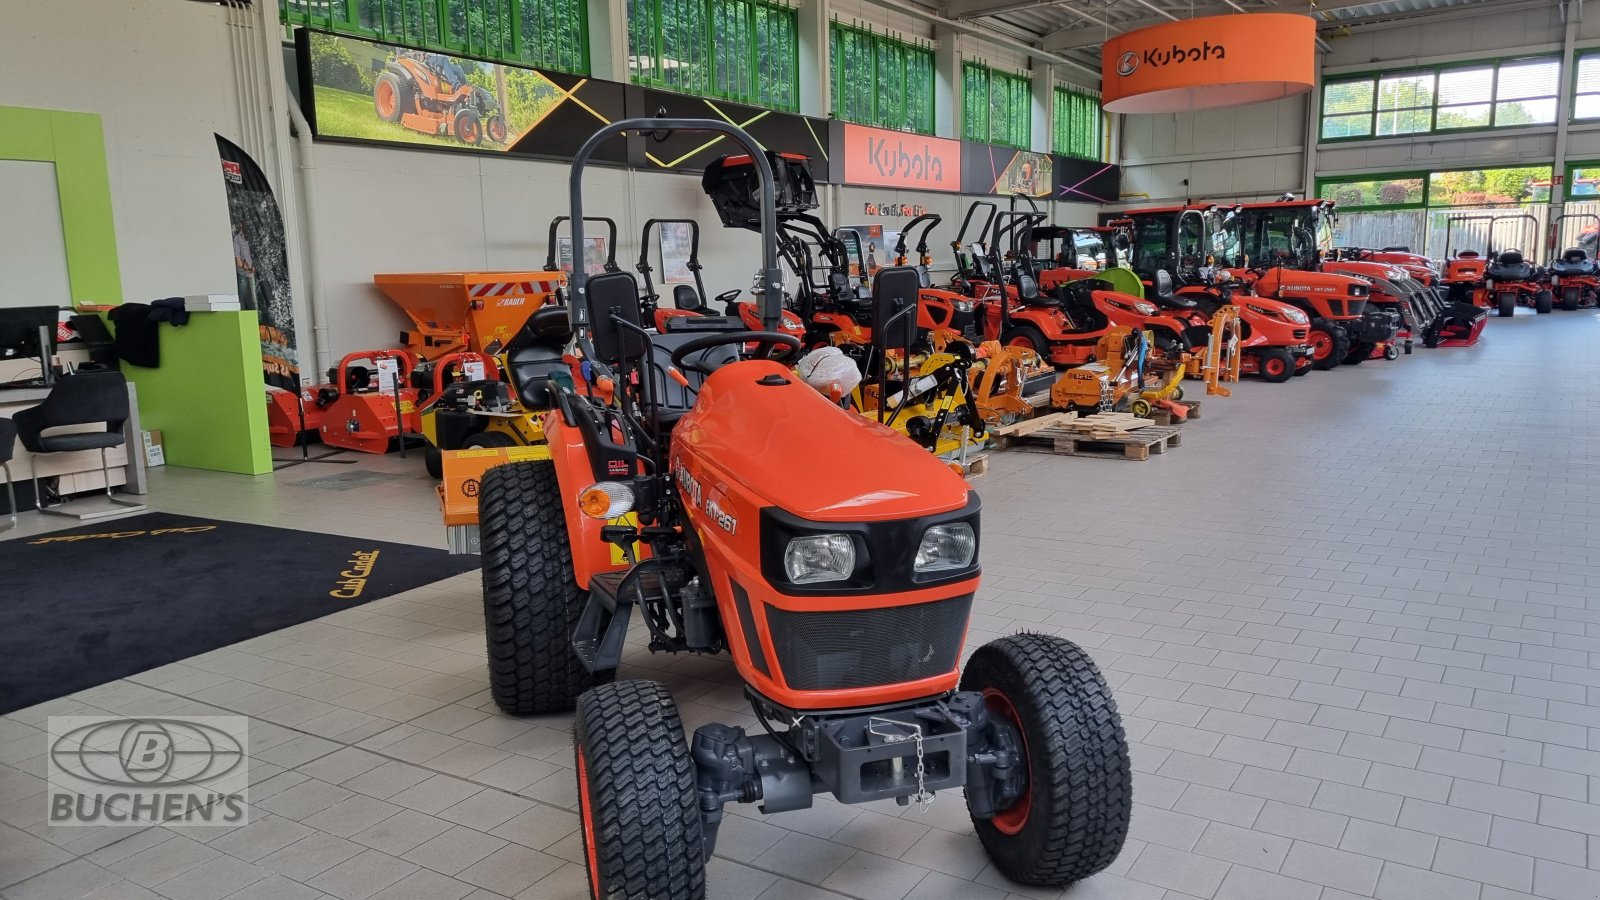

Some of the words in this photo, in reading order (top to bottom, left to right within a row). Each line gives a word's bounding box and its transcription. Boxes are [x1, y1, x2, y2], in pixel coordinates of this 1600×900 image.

[1143, 41, 1226, 67] Kubota
[868, 137, 943, 182] Kubota
[608, 460, 628, 469] OIL
[705, 499, 737, 536] EK1-261
[340, 550, 380, 578] Cadet
[330, 578, 366, 598] Cub
